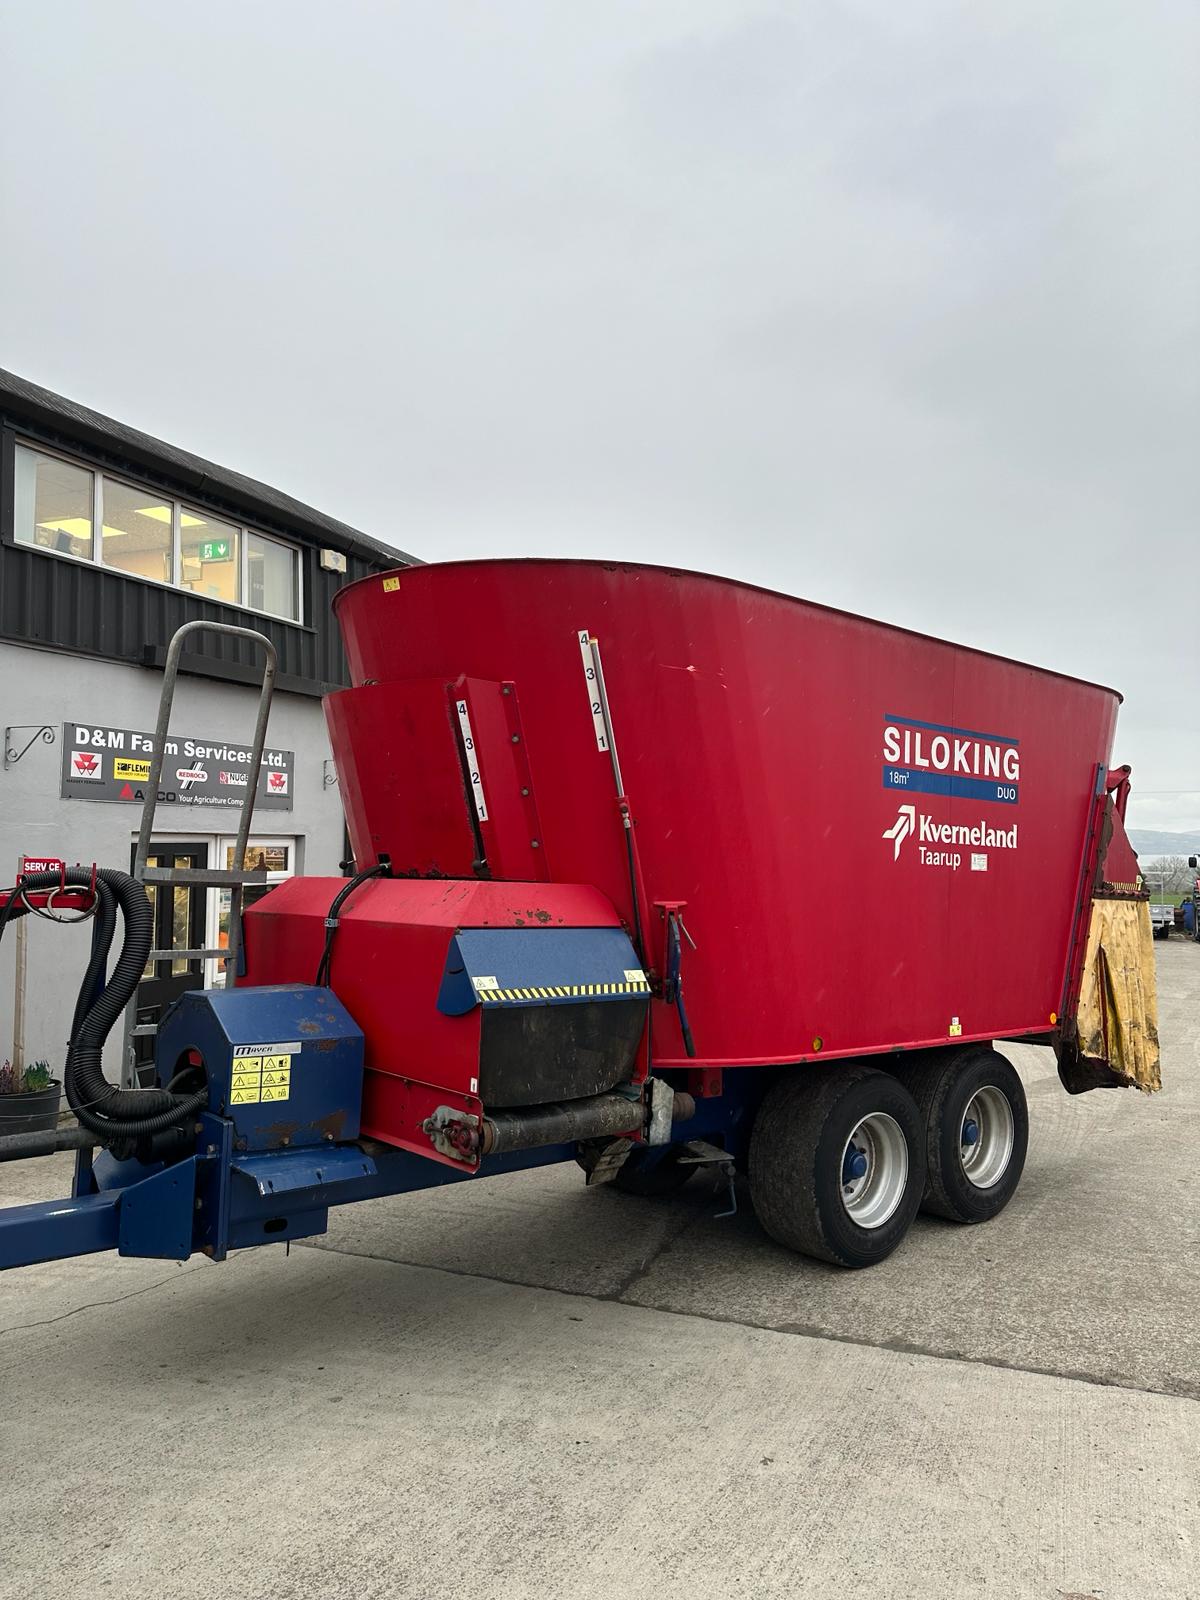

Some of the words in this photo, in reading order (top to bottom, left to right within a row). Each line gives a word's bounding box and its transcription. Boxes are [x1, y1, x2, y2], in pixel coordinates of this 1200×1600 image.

[580, 633, 589, 645] 4
[586, 667, 595, 680] 3
[592, 702, 601, 714] 2
[598, 735, 606, 748] 1
[75, 727, 125, 749] D&M
[131, 734, 179, 755] Fam
[184, 741, 253, 764] Services
[260, 752, 287, 768] Ltd.
[883, 726, 1020, 780] SILOKING
[458, 703, 467, 715] 4
[465, 737, 474, 750] 3
[471, 771, 480, 784] 2
[478, 805, 486, 818] 1
[178, 771, 206, 779] REDROCK
[134, 789, 176, 802] ACO
[179, 794, 193, 803] Your
[193, 796, 227, 804] Agriculture
[227, 797, 245, 807] Comp
[997, 786, 1016, 800] DUO
[918, 814, 1018, 849] Kverneland
[24, 862, 60, 872] SERVCE
[918, 846, 961, 871] Taarup
